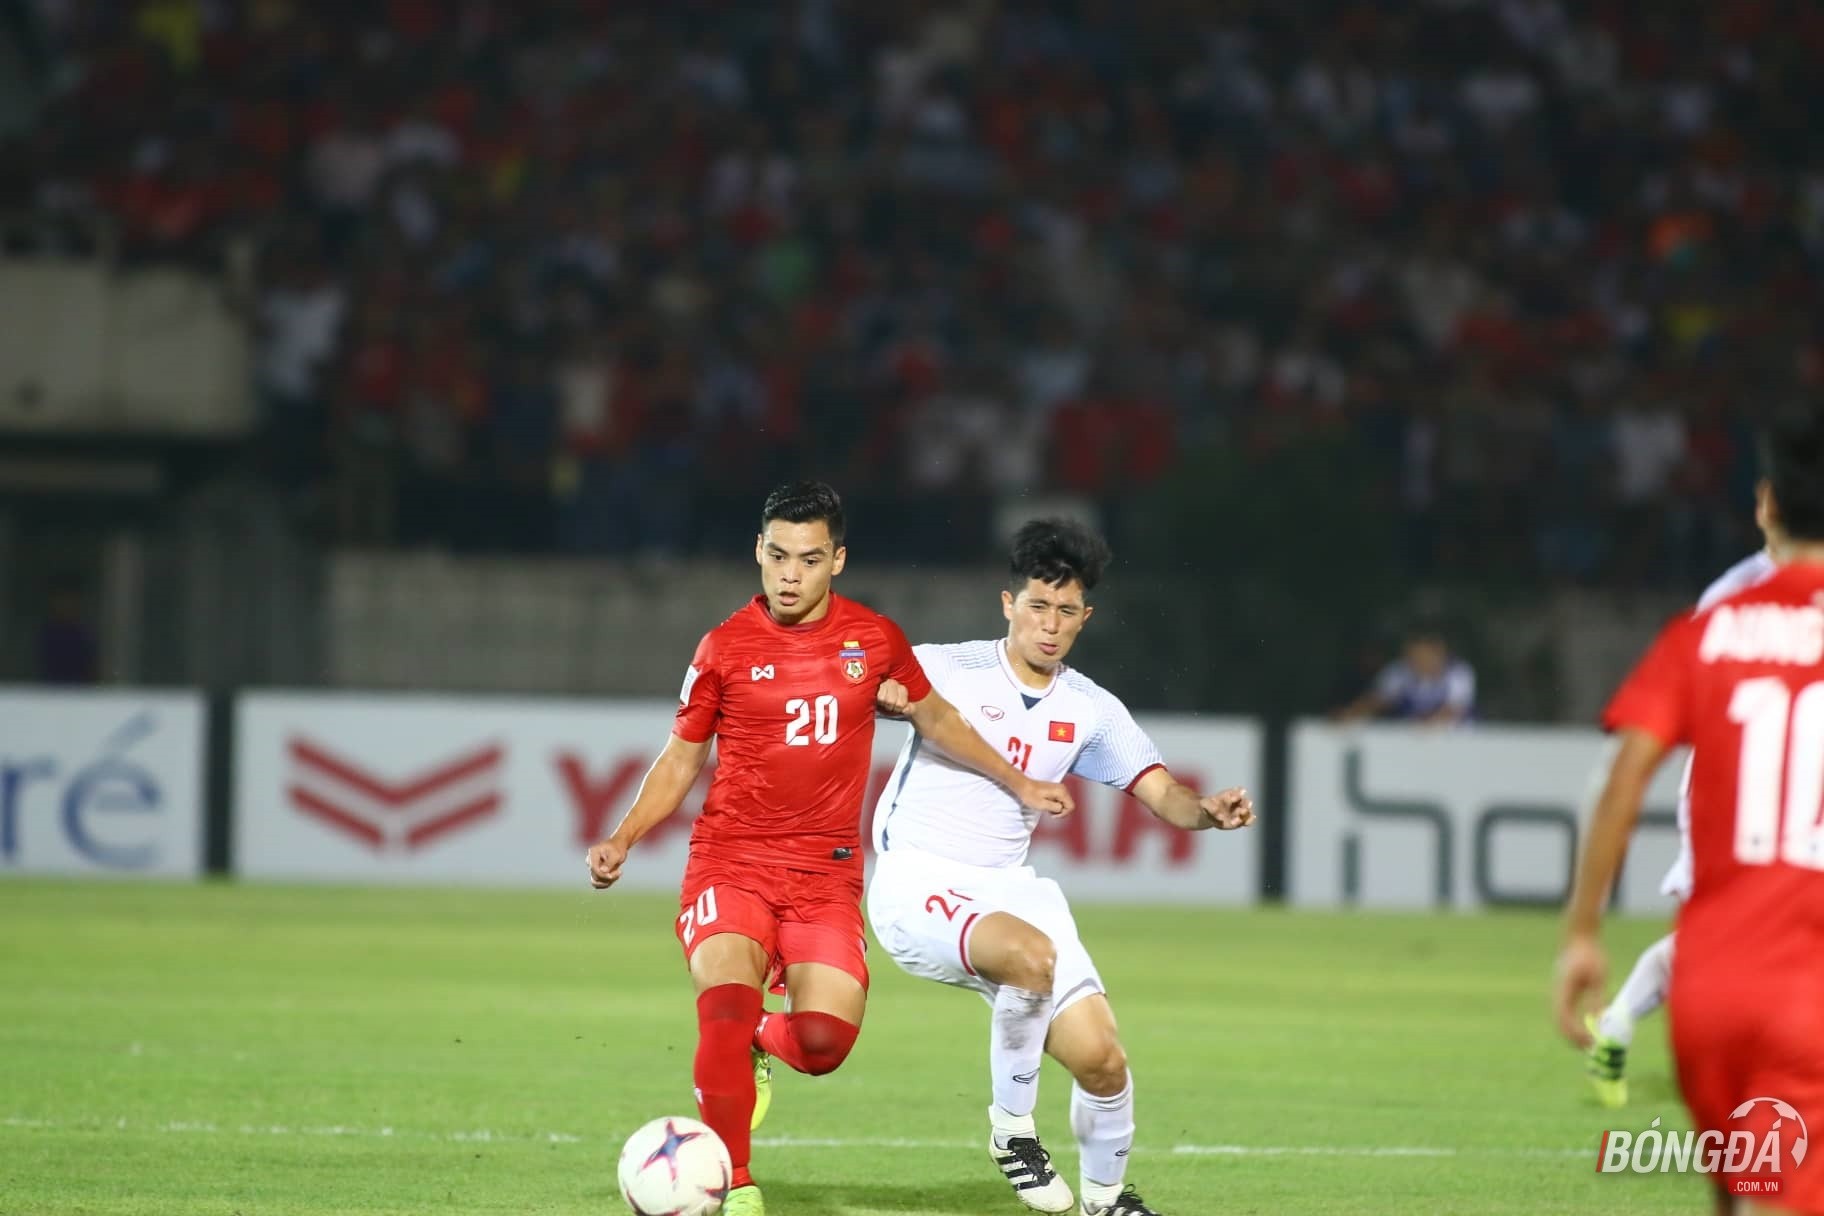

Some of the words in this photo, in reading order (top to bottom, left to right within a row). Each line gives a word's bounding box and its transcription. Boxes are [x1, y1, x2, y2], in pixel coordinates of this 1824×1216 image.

[785, 695, 838, 746] 20
[1007, 736, 1032, 772] 21
[680, 886, 718, 948] 20
